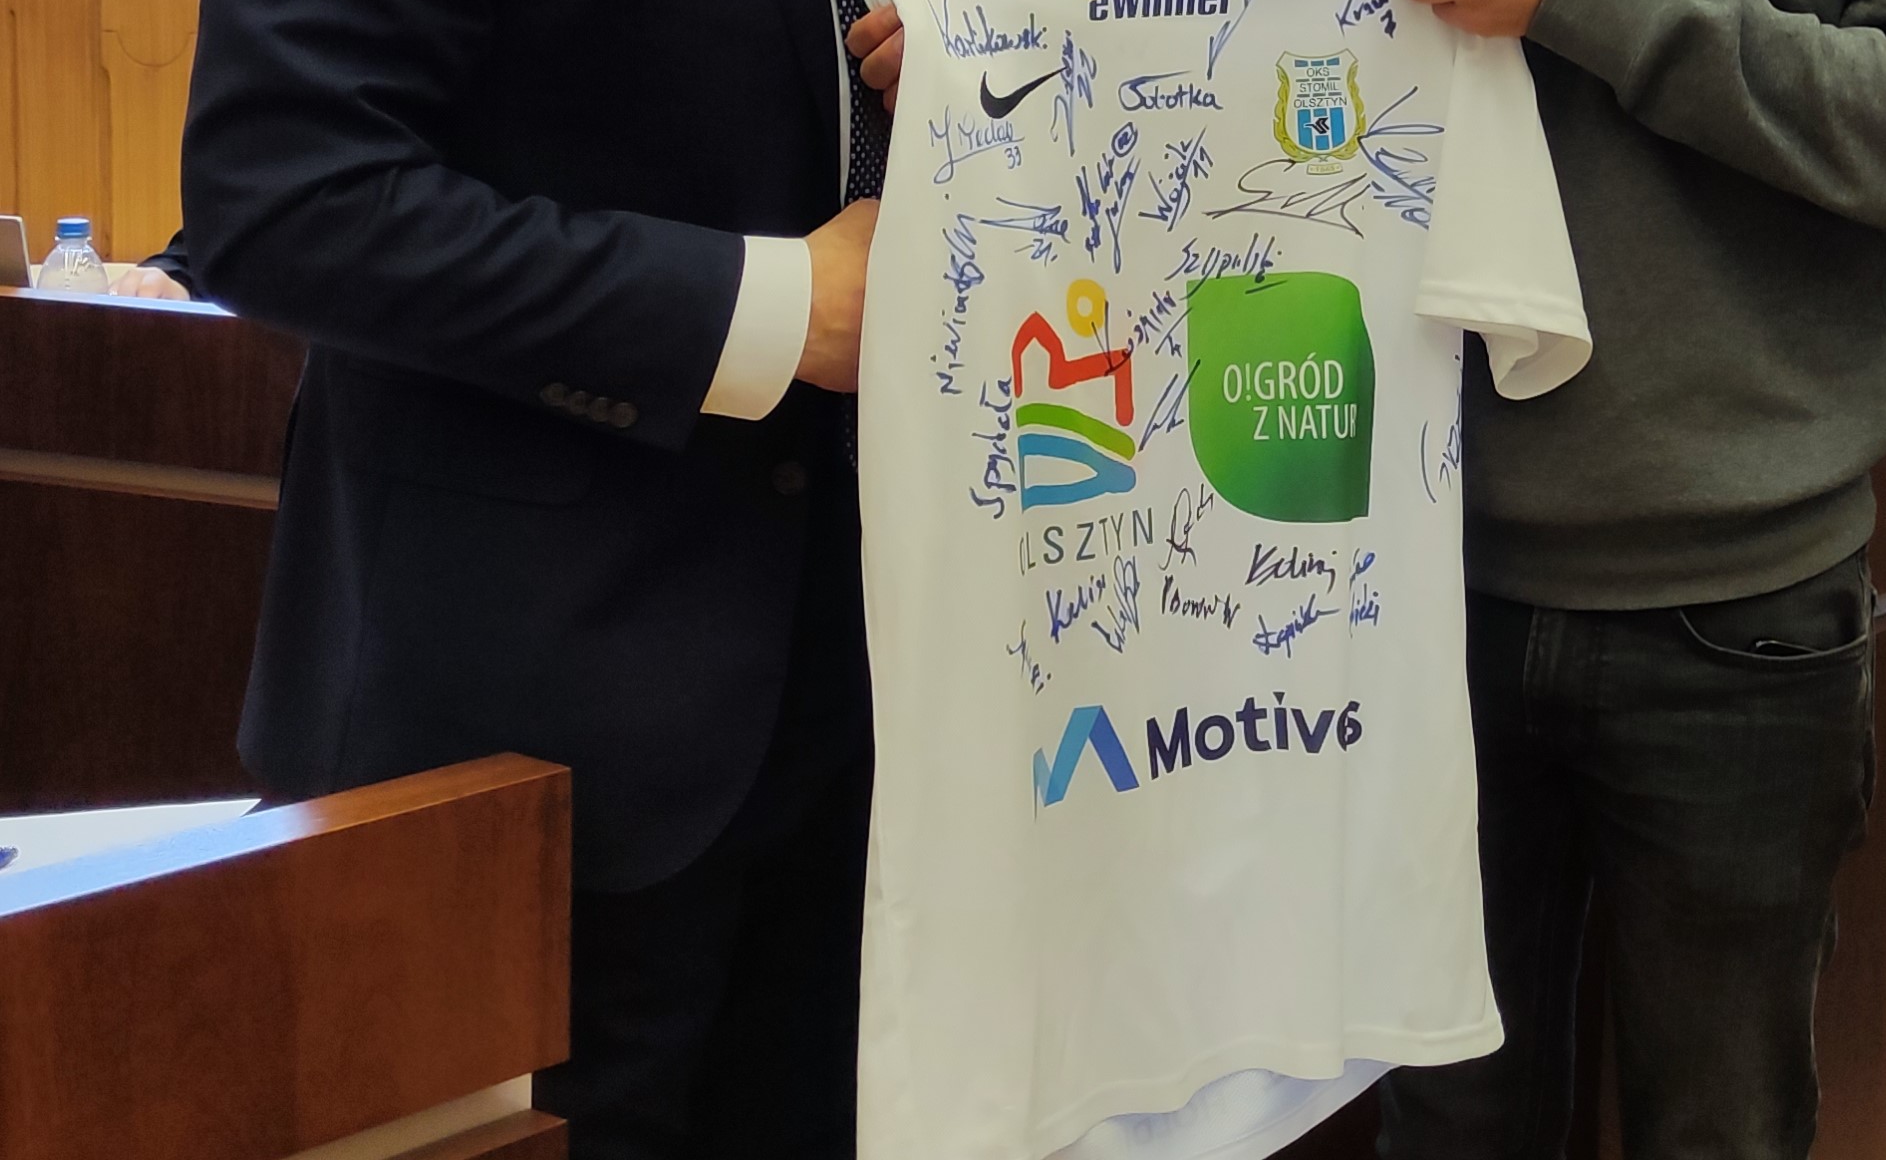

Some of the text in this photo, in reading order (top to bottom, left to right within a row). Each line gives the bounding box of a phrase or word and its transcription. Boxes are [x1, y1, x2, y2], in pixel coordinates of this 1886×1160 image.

[1306, 67, 1331, 78] OKS
[1299, 81, 1340, 94] STOMIL
[1293, 96, 1348, 109] OLSZTYN
[1222, 351, 1345, 404] O!GRÓD
[1252, 405, 1271, 441] Z
